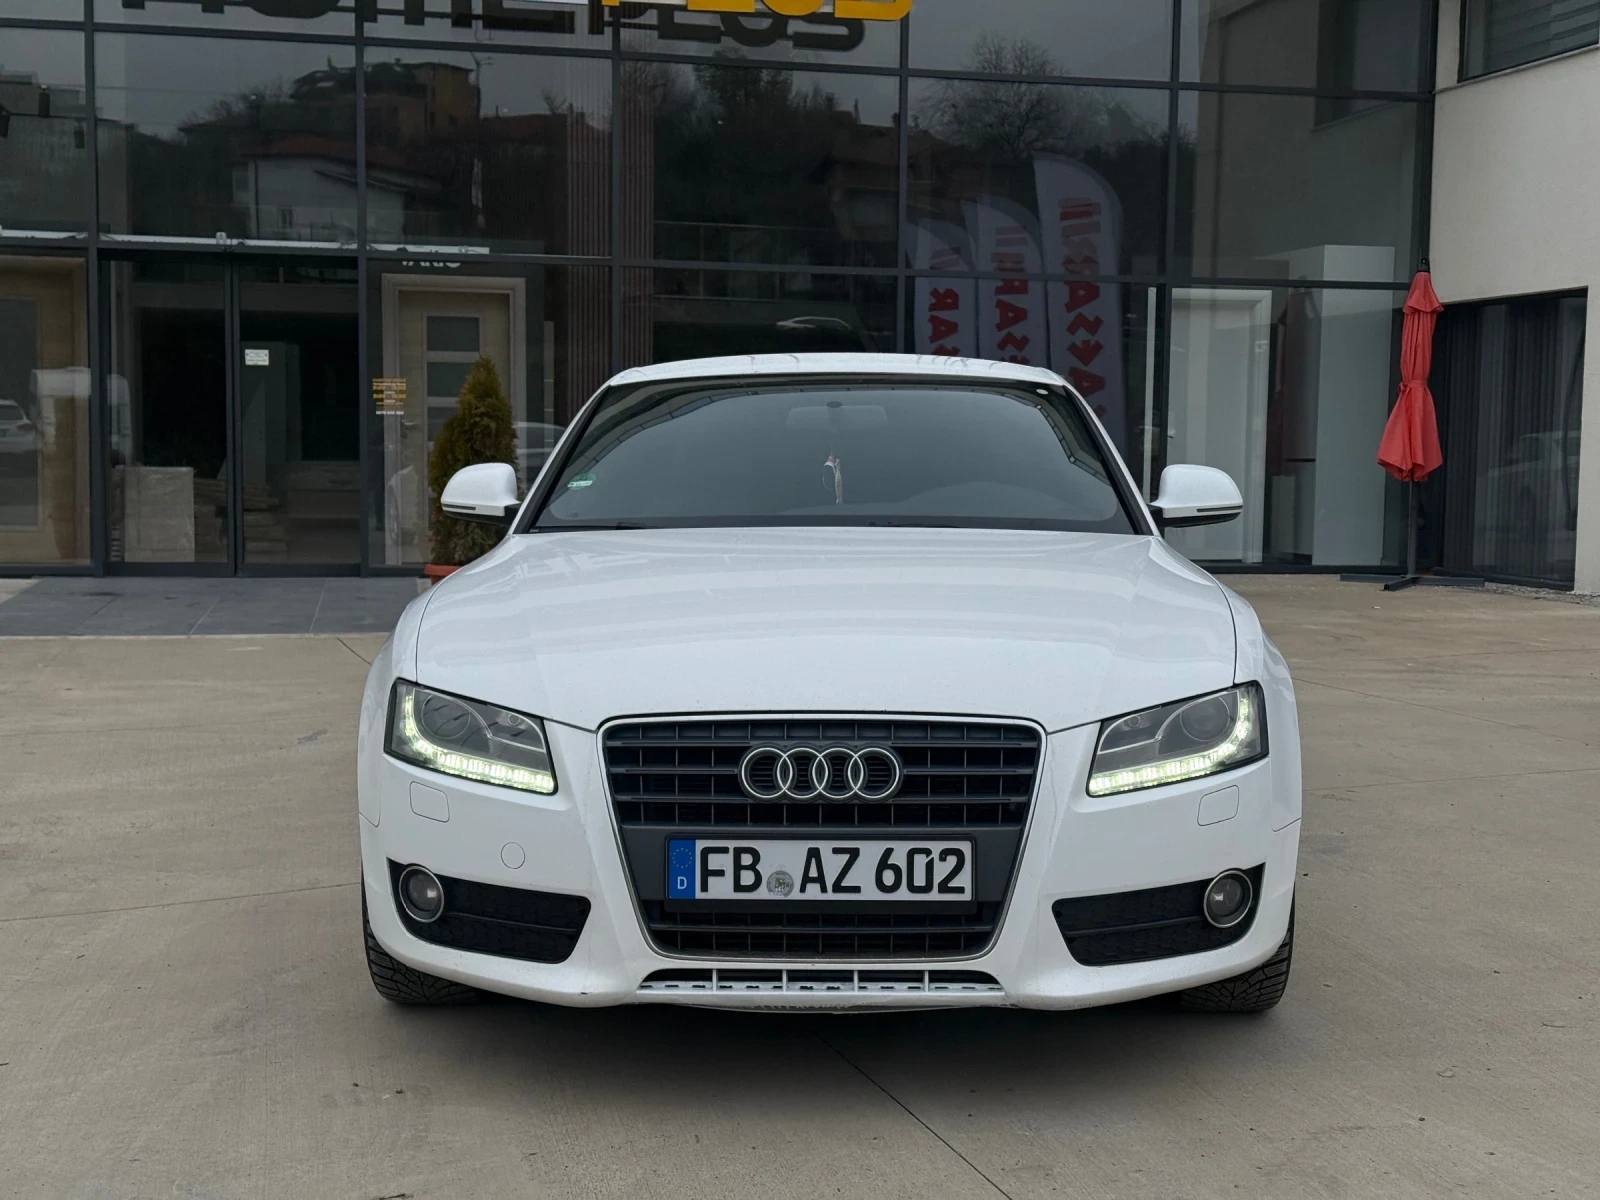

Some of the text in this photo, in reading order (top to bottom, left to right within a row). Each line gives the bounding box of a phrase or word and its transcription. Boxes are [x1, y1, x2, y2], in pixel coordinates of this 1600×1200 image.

[677, 876, 687, 890] D
[699, 846, 763, 893] FB
[799, 847, 862, 894] AZ
[875, 847, 966, 894] 602
